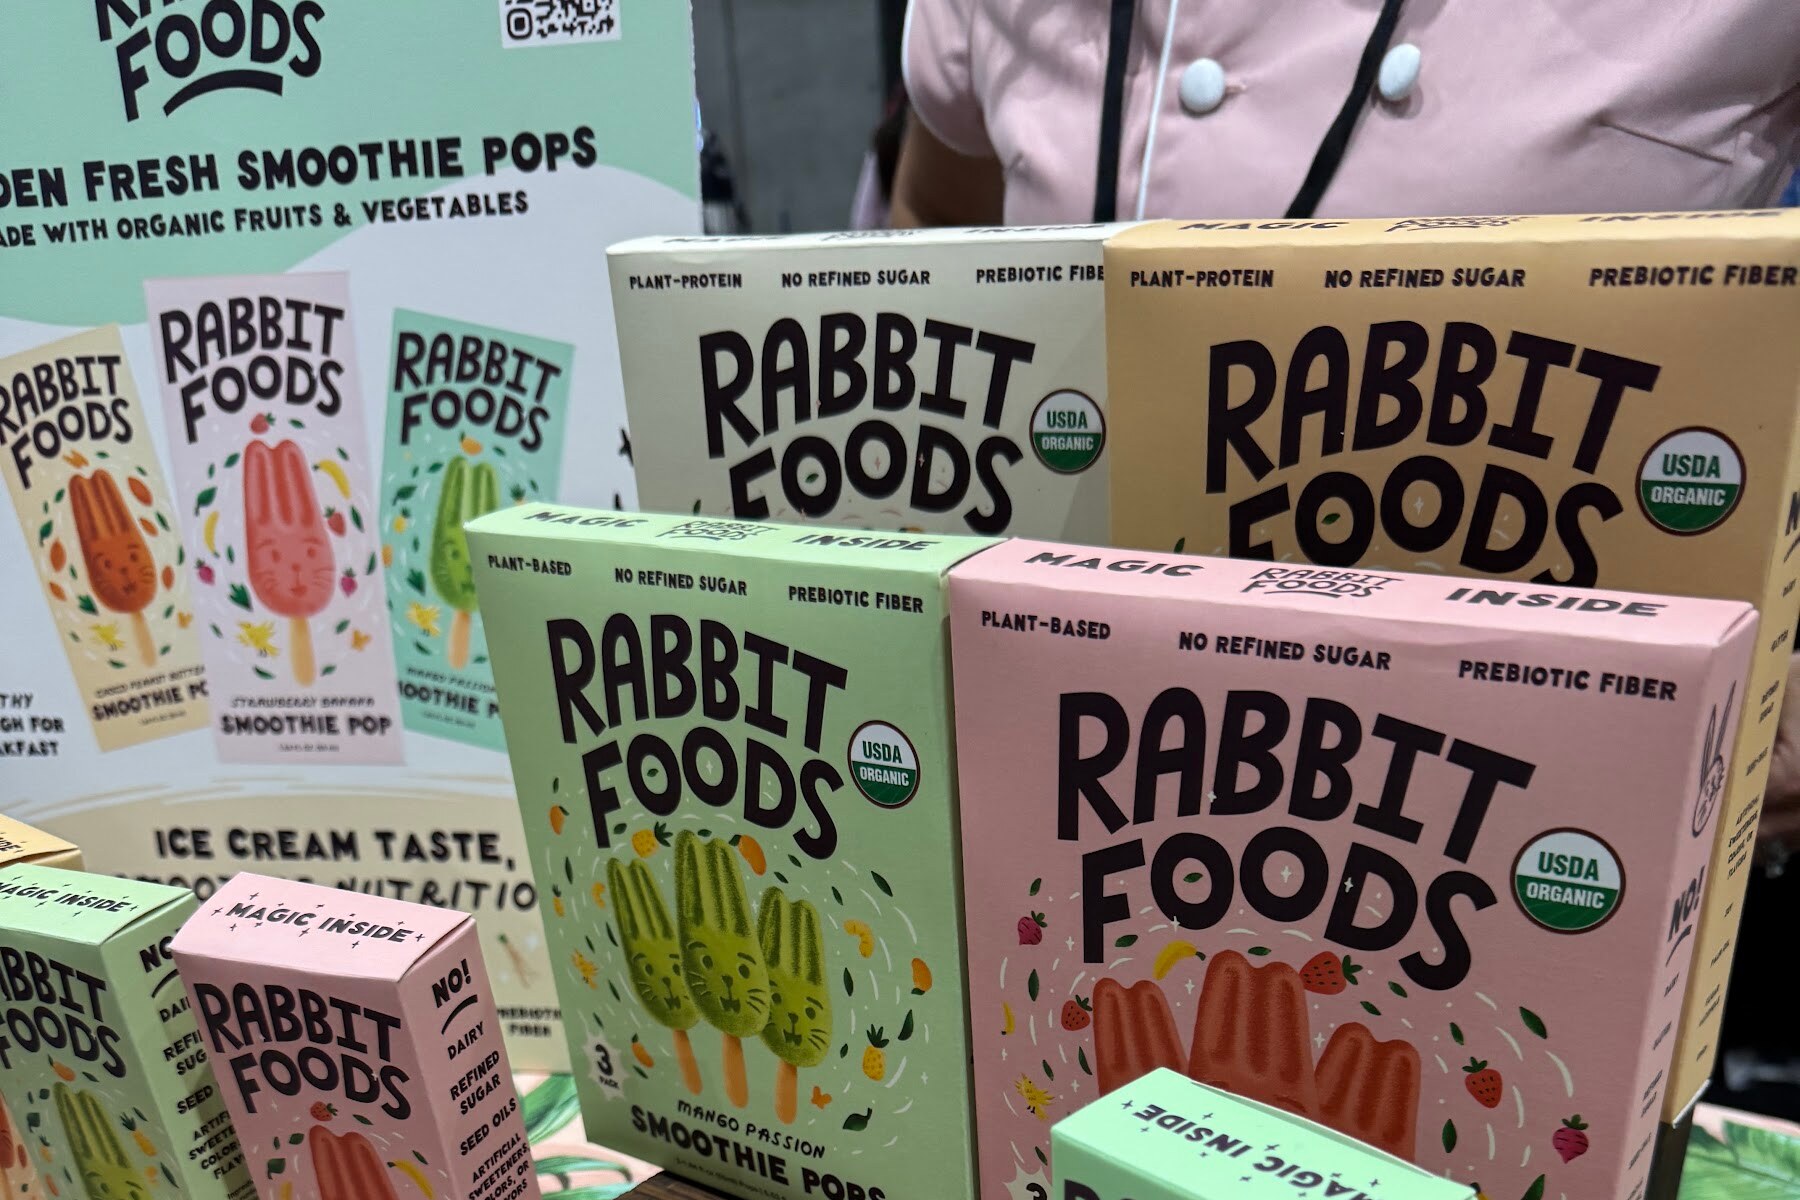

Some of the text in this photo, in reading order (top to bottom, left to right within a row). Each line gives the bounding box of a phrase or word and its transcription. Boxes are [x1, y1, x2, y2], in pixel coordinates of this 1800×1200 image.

[116, 0, 325, 122] FOODS
[83, 152, 219, 202] FRESH
[237, 136, 464, 190] SMOOTHIE
[482, 125, 597, 176] POPS
[42, 218, 108, 243] WITH
[117, 209, 225, 240] ORGANIC
[234, 203, 322, 232] FRUITS
[333, 203, 352, 228] &
[361, 190, 529, 224] VEGETABLES
[1178, 221, 1351, 231] MAGIC
[629, 273, 742, 290] PLANT-PROTEIN
[781, 269, 931, 288] NO REFINED SUGAR
[976, 265, 1063, 284] PREBIOTIC
[1130, 269, 1274, 288] PLANT-PROTEIN
[1325, 267, 1526, 288] NO REFINED SUGAR
[1589, 264, 1799, 287] PREBIOTIC FIBER
[160, 296, 345, 384] RABBIT
[394, 332, 563, 404] RABBIT
[699, 312, 1036, 459] RABBIT
[0, 355, 121, 445] RABBIT
[181, 355, 345, 444] FOODS
[1205, 320, 1662, 494] RABBIT
[400, 388, 550, 453] FOODS
[1046, 410, 1089, 430] USDA
[11, 398, 133, 490] FOODS
[1041, 435, 1094, 451] ORGANIC
[729, 420, 1024, 535] FOODS
[1662, 453, 1721, 479] USDA
[1650, 485, 1726, 507] ORGANIC
[524, 511, 649, 528] MAGIC
[1228, 455, 1624, 588] FOODS
[793, 534, 942, 551] INSIDE
[488, 554, 572, 577] PLANT-BASED
[614, 567, 747, 596] NO REFINED SUGAR
[1025, 551, 1205, 577] MAGIC
[1250, 567, 1404, 587] RABBIT
[788, 585, 924, 614] PREBIOTIC FIBER
[1240, 578, 1384, 598] FOODS
[1445, 587, 1668, 618] INSIDE
[981, 610, 1111, 640] PLANT-BASED
[1179, 631, 1391, 671] NO REFINED SUGAR
[546, 612, 848, 754] RABBIT
[1458, 660, 1677, 701] PREBIOTIC FIBER
[91, 686, 184, 722] SMOOTHIE
[220, 714, 393, 736] SMOOTHIE POP
[862, 740, 903, 764] USDA
[582, 726, 845, 860] FOODS
[858, 765, 909, 788] ORGANIC
[1057, 686, 1537, 865] RABBIT
[155, 827, 517, 873] ICE CREAM TASTE,
[1537, 850, 1600, 882] USDA
[0, 882, 132, 913] MAGIC INSIDE
[1081, 826, 1498, 992] FOODS
[1526, 881, 1605, 911] ORGANIC
[1667, 866, 1705, 943] NO!
[225, 902, 415, 944] MAGIC INSIDE
[431, 958, 472, 1009] NO!
[193, 982, 401, 1062] RABBIT
[447, 1020, 485, 1061] DAIRY
[450, 1049, 501, 1102] REFINED
[594, 1044, 613, 1076] 3
[177, 1085, 214, 1115] SEED
[229, 1046, 411, 1120] FOODS
[460, 1073, 502, 1116] SUGAR
[460, 1097, 518, 1156] SEED OILS
[630, 1104, 790, 1187] SMOOTHIE
[677, 1098, 826, 1159] MANGO PASSION
[1132, 1103, 1251, 1157] INSIDE
[201, 1141, 242, 1170] COLOR
[472, 1132, 522, 1184] ARTIFICIAL
[516, 1159, 531, 1178] OR
